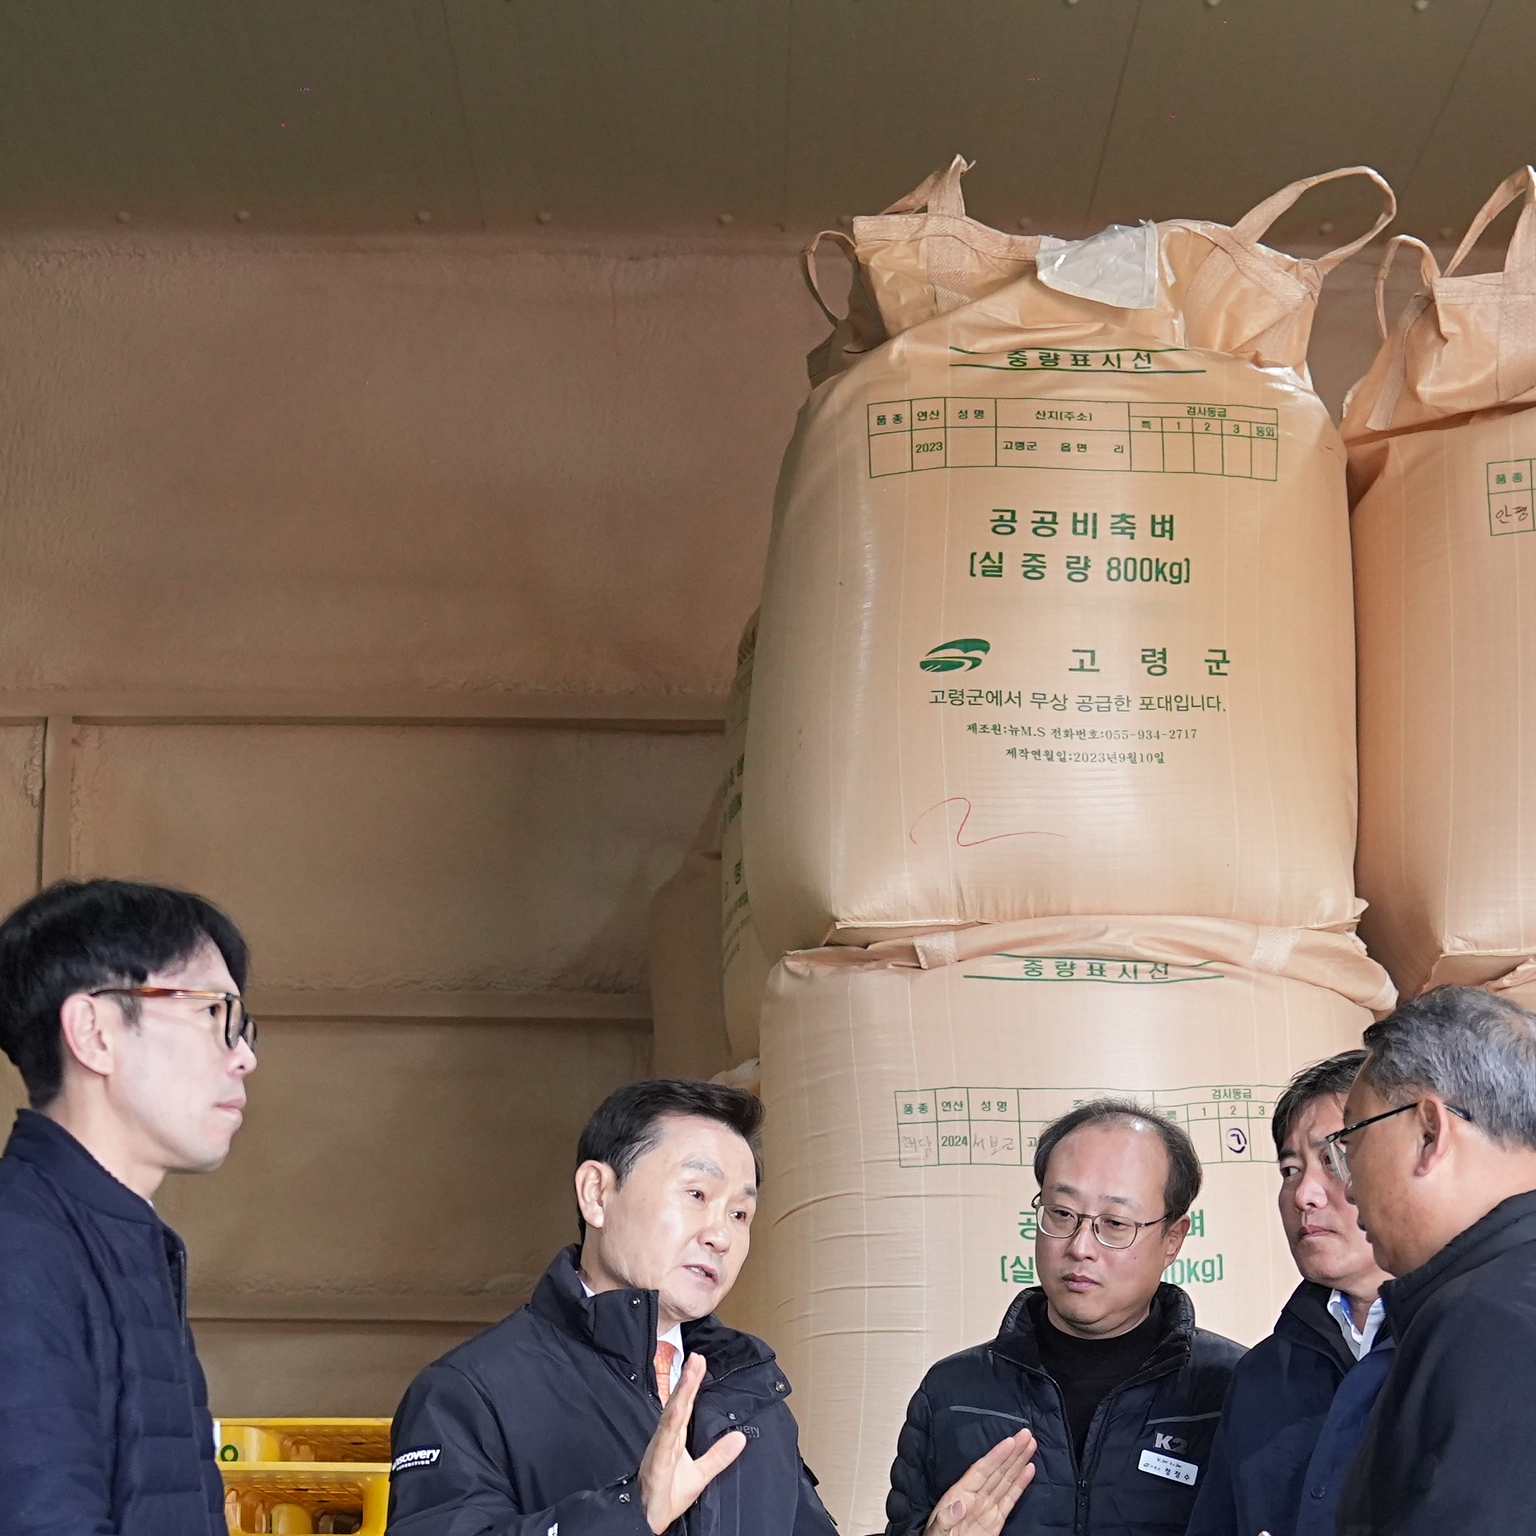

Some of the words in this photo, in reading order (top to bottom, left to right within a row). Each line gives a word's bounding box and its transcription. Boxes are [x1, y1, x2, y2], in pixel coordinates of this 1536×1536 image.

[917, 410, 940, 422] 연산
[958, 409, 985, 420] 성명
[1035, 410, 1092, 421] 산지(주소)
[1176, 421, 1181, 431] 1
[1204, 422, 1211, 432] 2
[1233, 424, 1240, 434] 3
[915, 442, 943, 454] 2023
[1002, 441, 1037, 452] 고령군
[1068, 647, 1231, 677] 고령군
[928, 688, 1023, 709] 고령군에서
[1030, 691, 1068, 712] 무상
[1076, 694, 1131, 713] 공급한
[1138, 694, 1227, 713] 포대입니다.
[942, 1101, 963, 1112] 연산
[981, 1101, 1007, 1112] 성명
[1202, 1107, 1207, 1117] 1
[1230, 1105, 1236, 1116] 2
[1258, 1105, 1265, 1116] 3
[941, 1136, 969, 1148] 2024
[1154, 1432, 1188, 1455] K2
